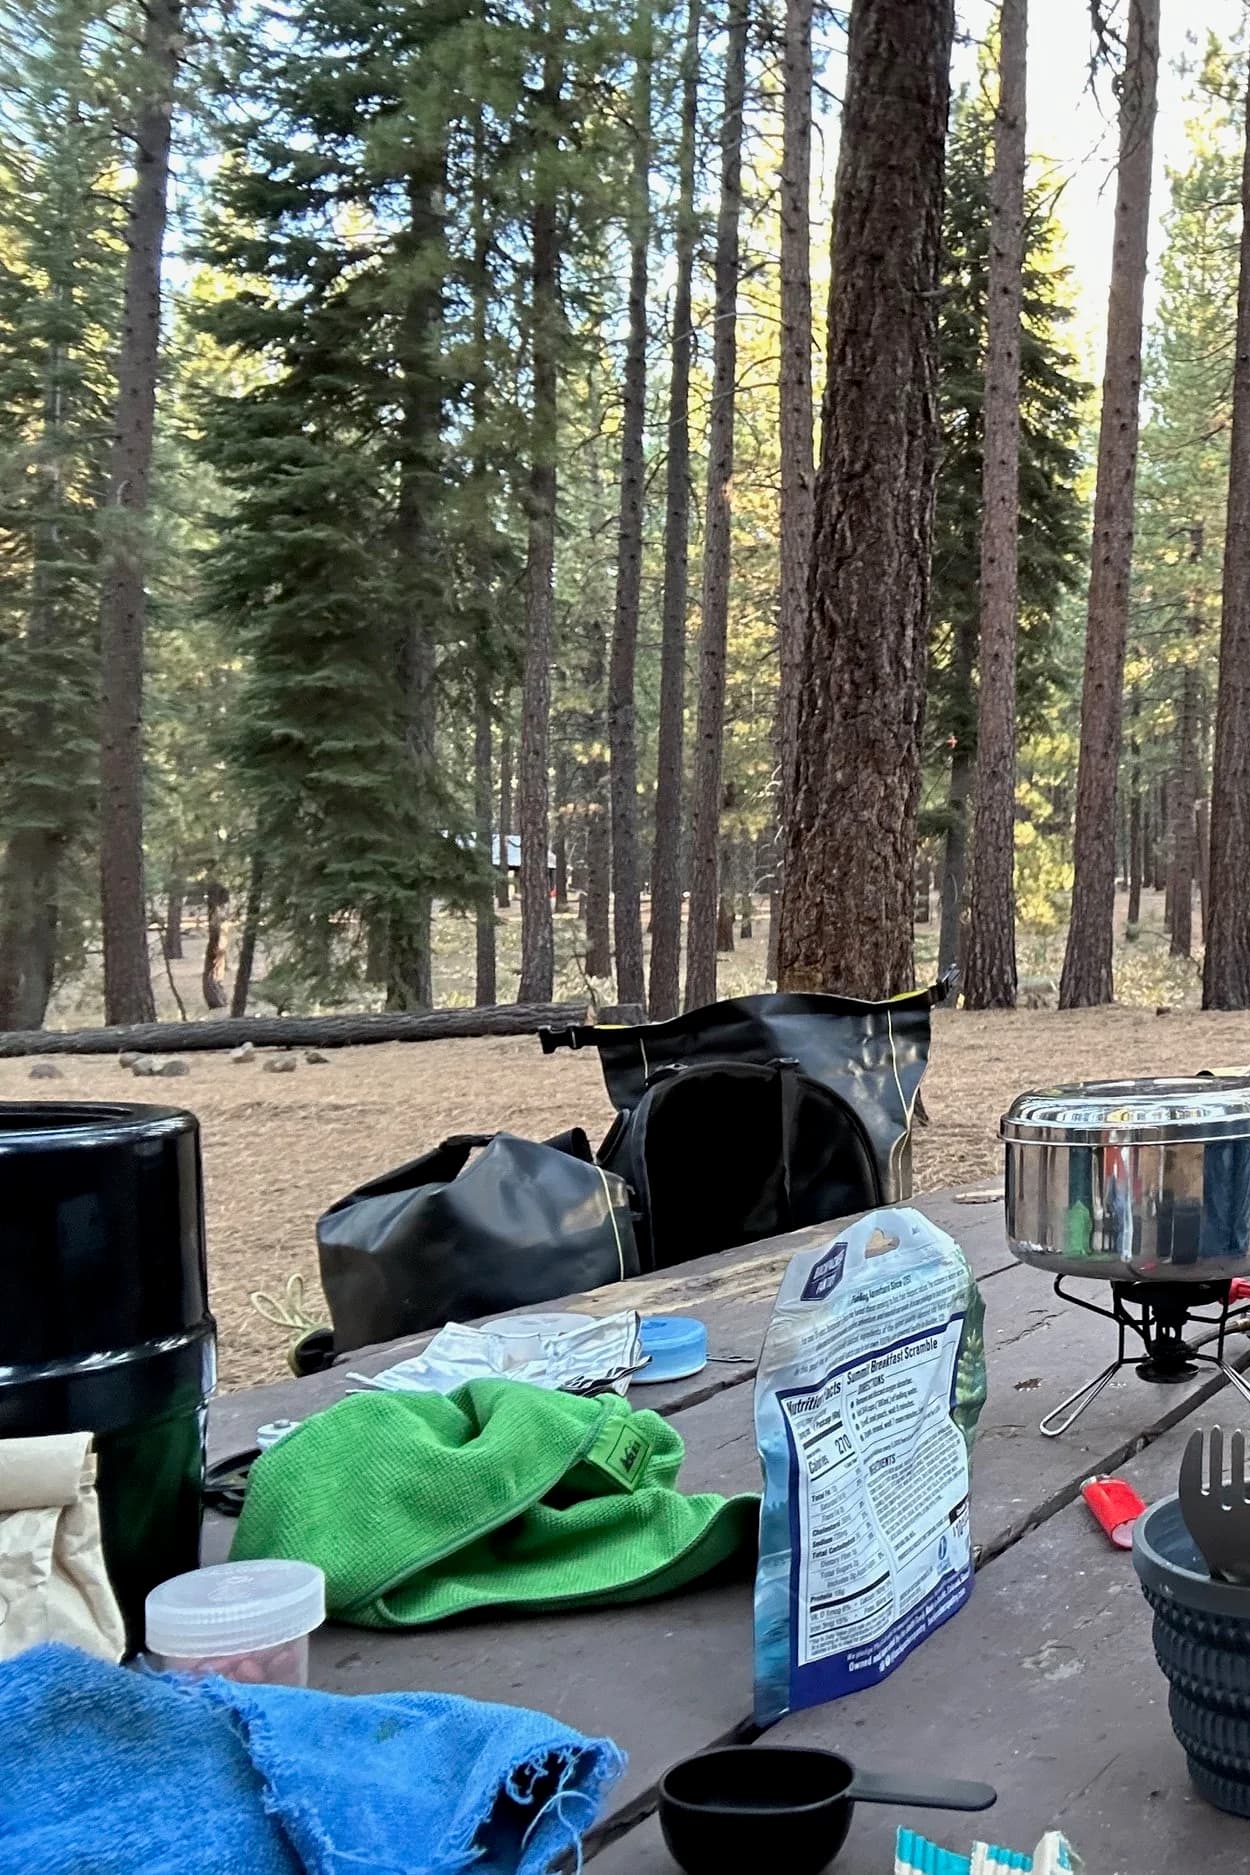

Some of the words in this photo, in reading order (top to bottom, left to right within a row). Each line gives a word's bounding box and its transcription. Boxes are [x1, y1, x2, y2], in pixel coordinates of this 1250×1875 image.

[871, 1349, 904, 1373] Breakfast
[904, 1337, 938, 1359] Scramble
[834, 1433, 852, 1455] 270
